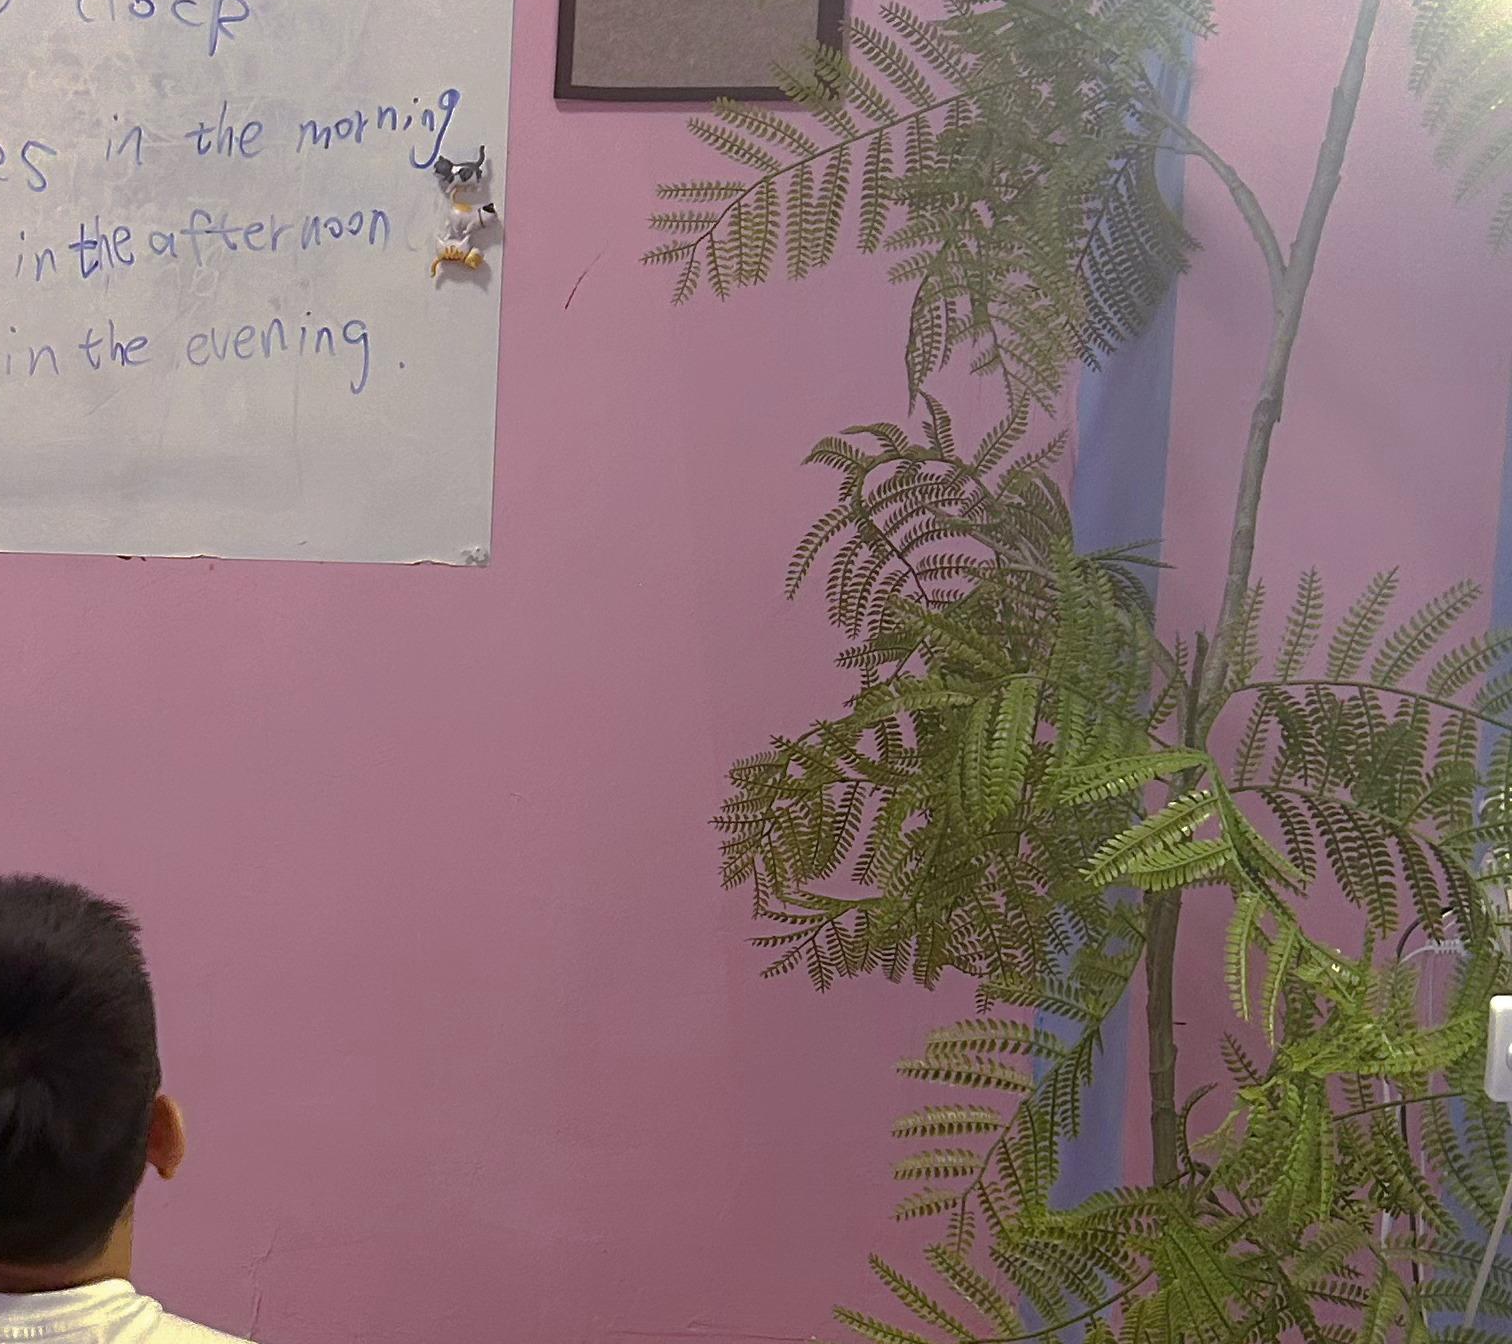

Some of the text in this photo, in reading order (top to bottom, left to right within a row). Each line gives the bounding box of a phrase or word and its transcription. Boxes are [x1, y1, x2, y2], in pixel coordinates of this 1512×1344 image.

[105, 114, 143, 166] in
[185, 100, 261, 157] the
[297, 88, 460, 170] morning
[15, 207, 390, 282] in the afternoon
[5, 326, 59, 377] in
[78, 320, 150, 370] the
